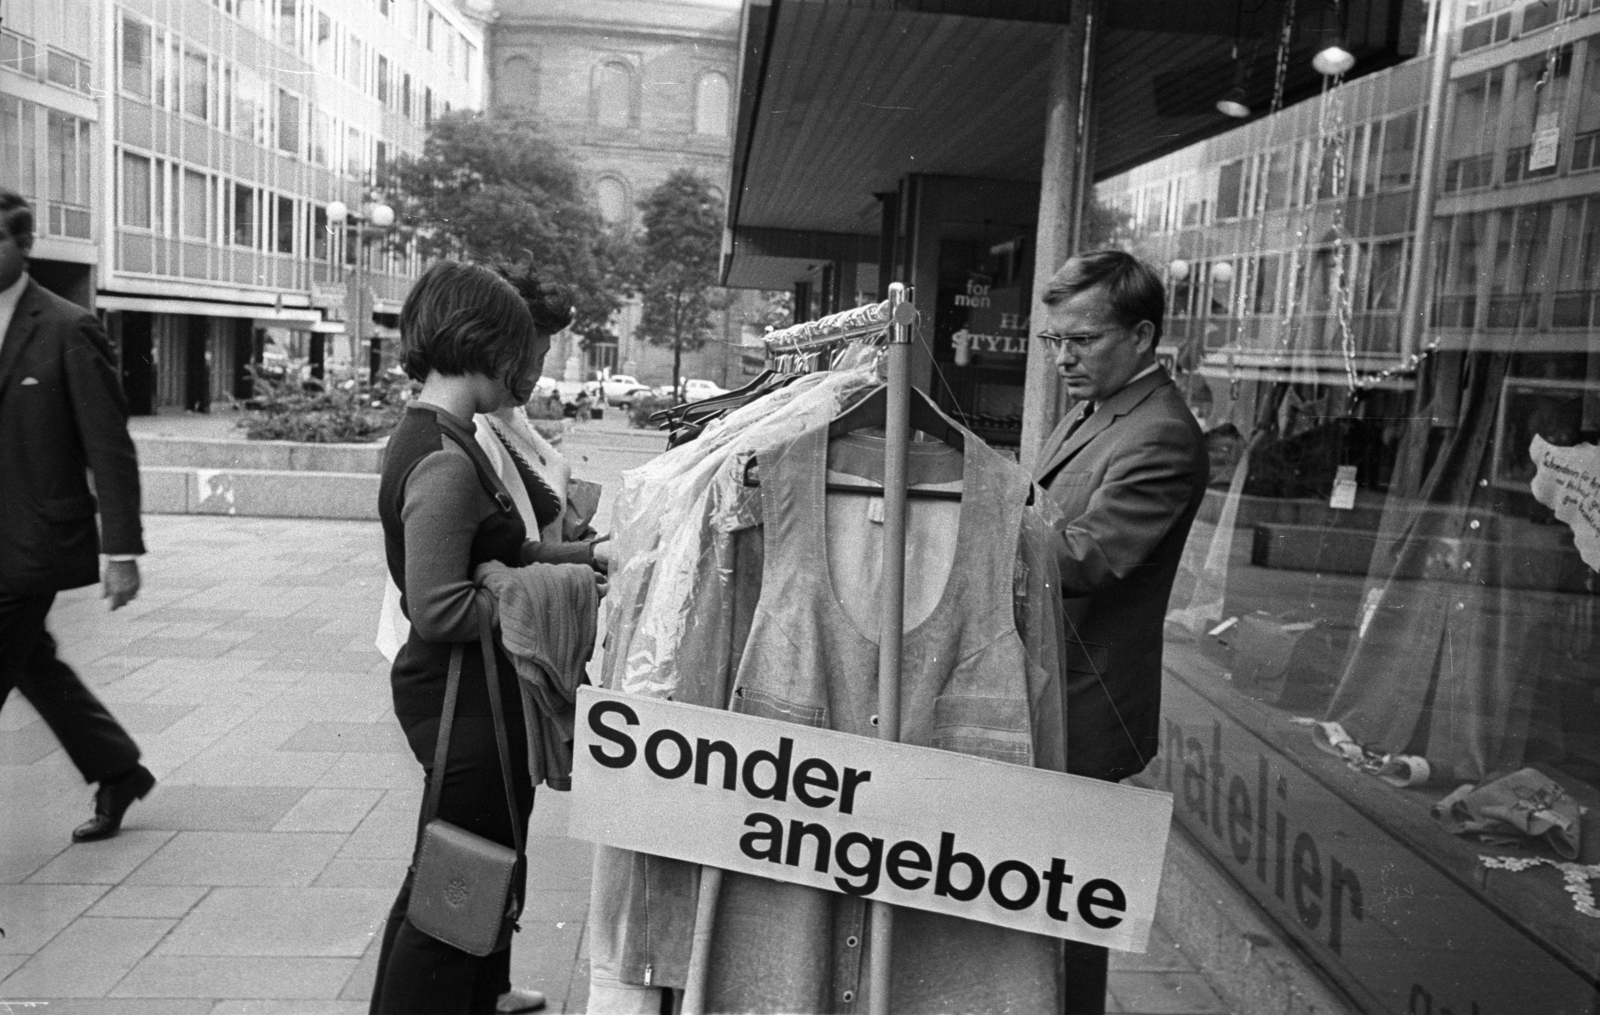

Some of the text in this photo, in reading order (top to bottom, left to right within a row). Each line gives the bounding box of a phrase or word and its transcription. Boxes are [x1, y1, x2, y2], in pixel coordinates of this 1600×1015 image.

[954, 294, 991, 308] men
[966, 279, 991, 296] for
[587, 700, 871, 815] Sonder
[739, 811, 1128, 930] angebote
